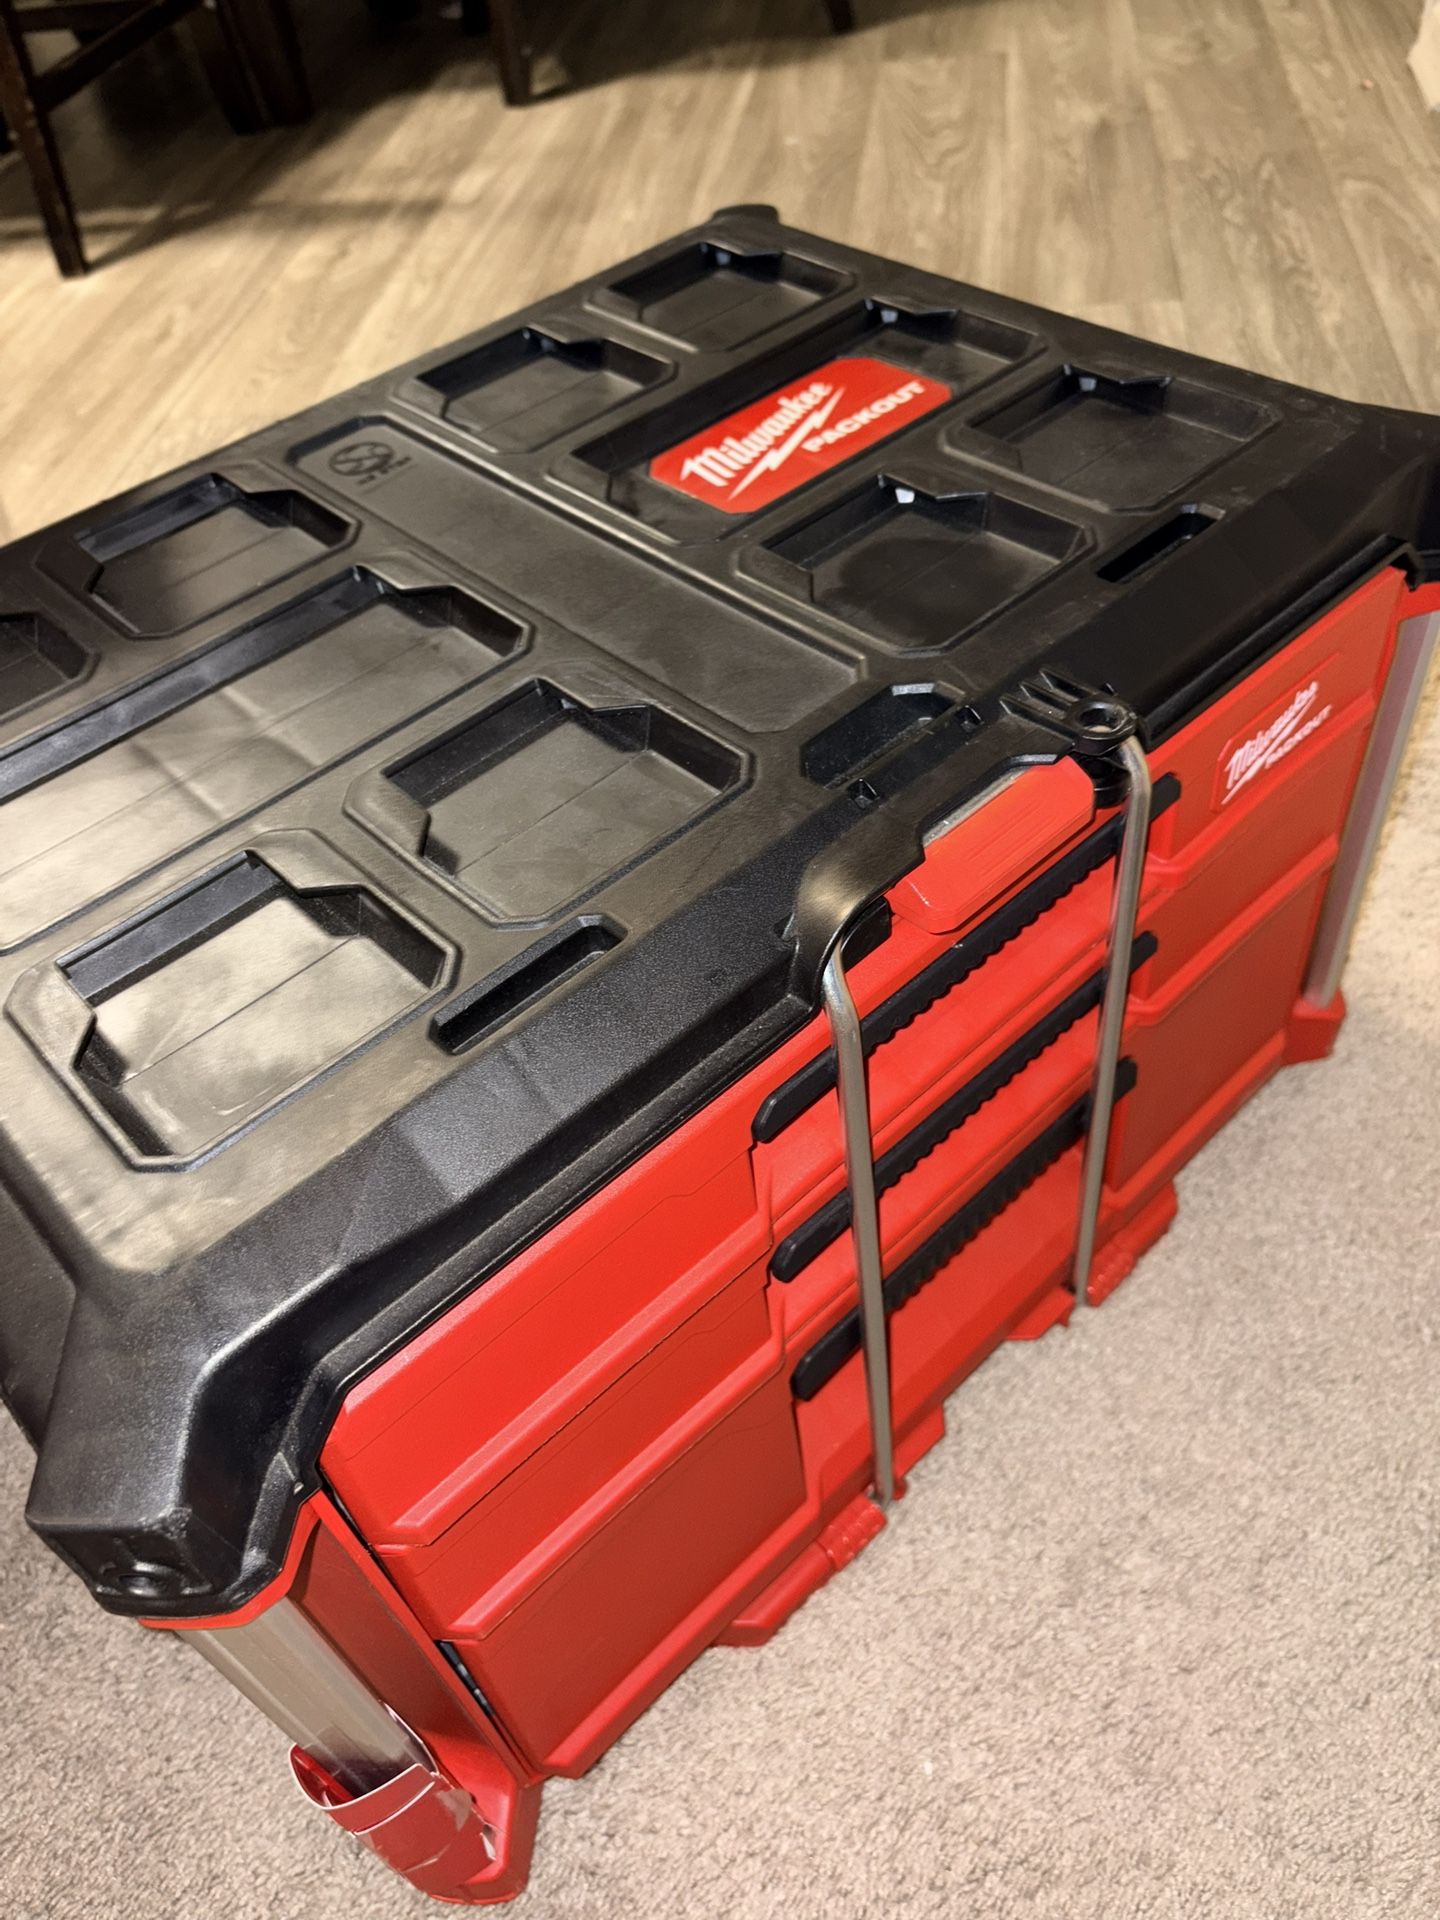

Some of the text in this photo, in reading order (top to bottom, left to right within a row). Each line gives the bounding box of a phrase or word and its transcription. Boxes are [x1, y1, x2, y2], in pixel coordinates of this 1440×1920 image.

[680, 382, 831, 486] Milwaukee
[802, 381, 925, 452] PACKOUT
[1224, 681, 1318, 789] Milwaukee
[1265, 704, 1332, 769] PACKOUT
